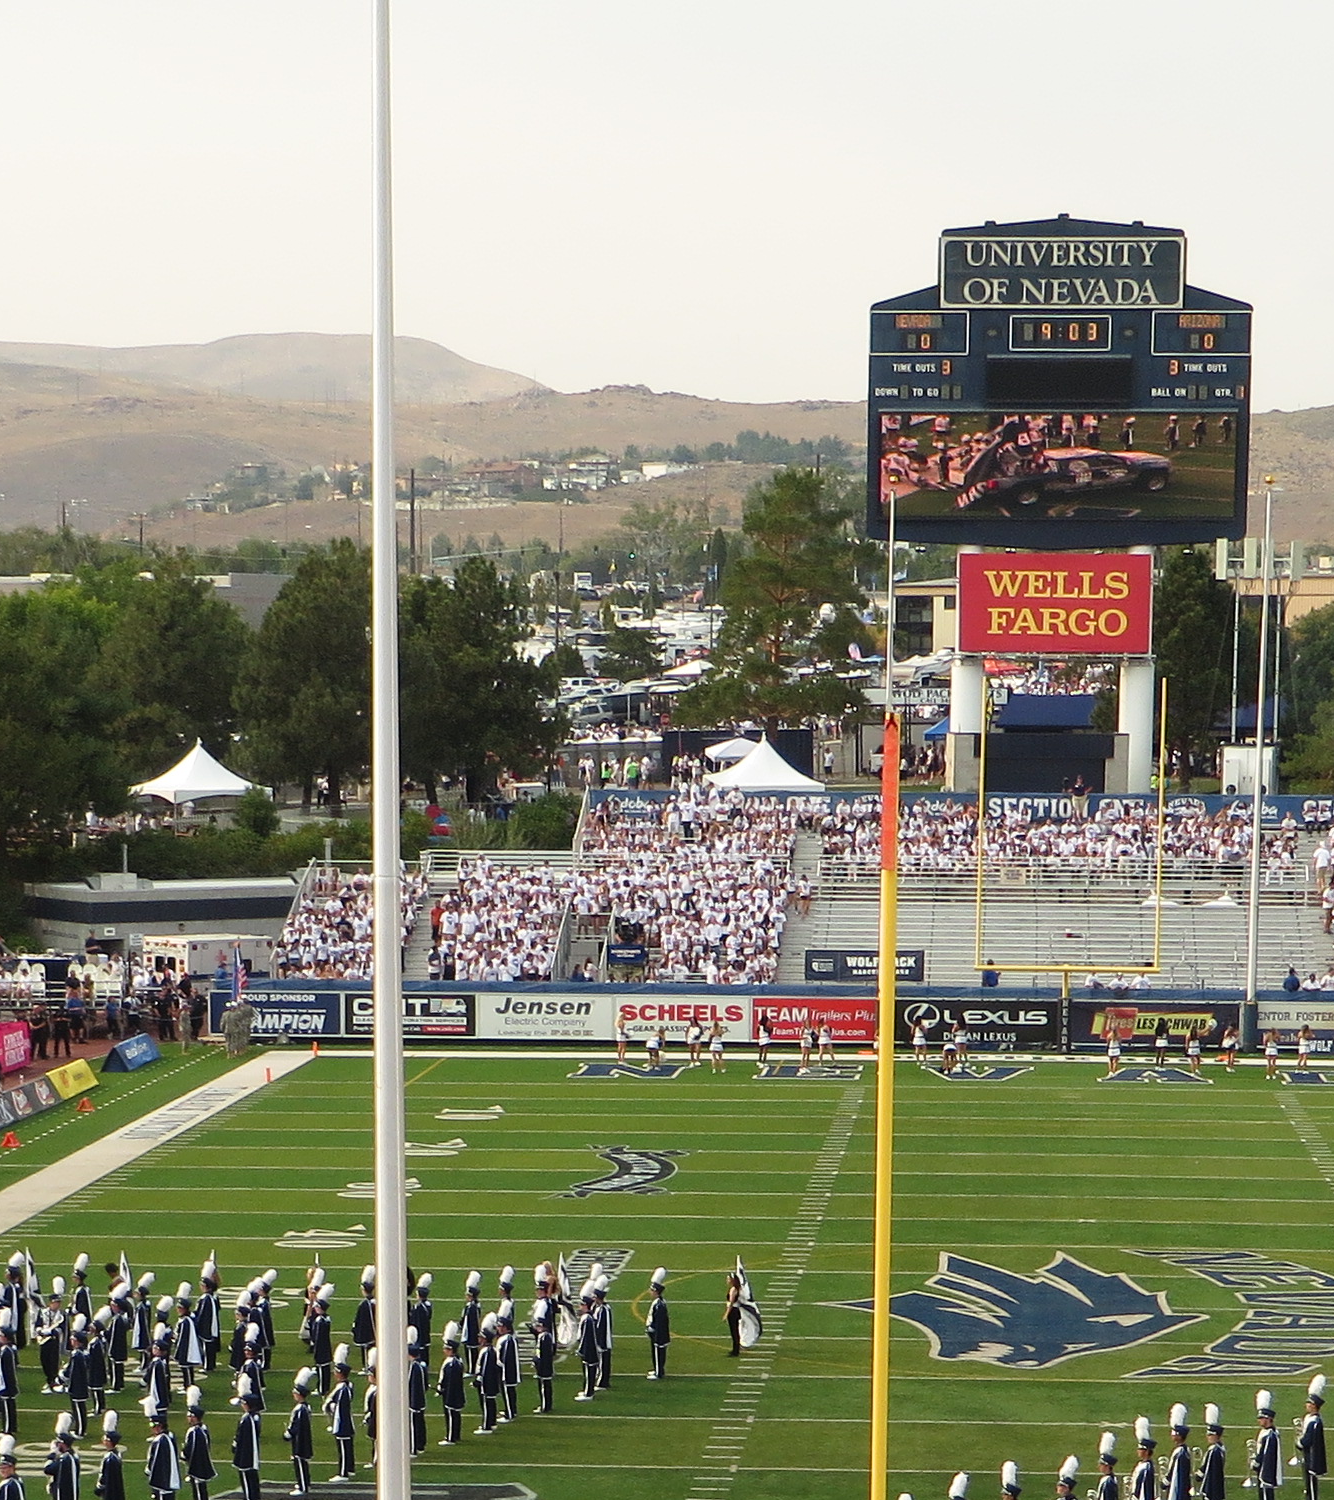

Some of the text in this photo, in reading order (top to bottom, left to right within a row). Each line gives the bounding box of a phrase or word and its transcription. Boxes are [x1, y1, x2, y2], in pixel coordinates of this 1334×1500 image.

[965, 242, 1158, 267] UNIVERSITY
[963, 278, 1158, 305] OF NEVADA
[1040, 323, 1098, 341] 9:03
[921, 334, 930, 349] 0
[1204, 334, 1213, 349] 0
[893, 360, 950, 375] TIME OUTS 3
[1169, 360, 1227, 375] 3 TIME OUTS
[875, 388, 939, 397] DOWN TO GO
[1151, 388, 1171, 396] BALL
[1174, 388, 1187, 396] ON
[985, 571, 1130, 599] WELLS
[987, 608, 1128, 636] FARGO
[269, 994, 316, 1002] SPONSOR
[495, 997, 593, 1015] Jensen
[620, 1004, 744, 1022] SCHEELS
[504, 1016, 587, 1028] Electric Company
[754, 1007, 808, 1022] TEAM
[809, 1008, 853, 1022] Trailers
[943, 1009, 1048, 1025] LEXUS
[1136, 1018, 1155, 1030] LES
[983, 1032, 1017, 1042] LEXUS
